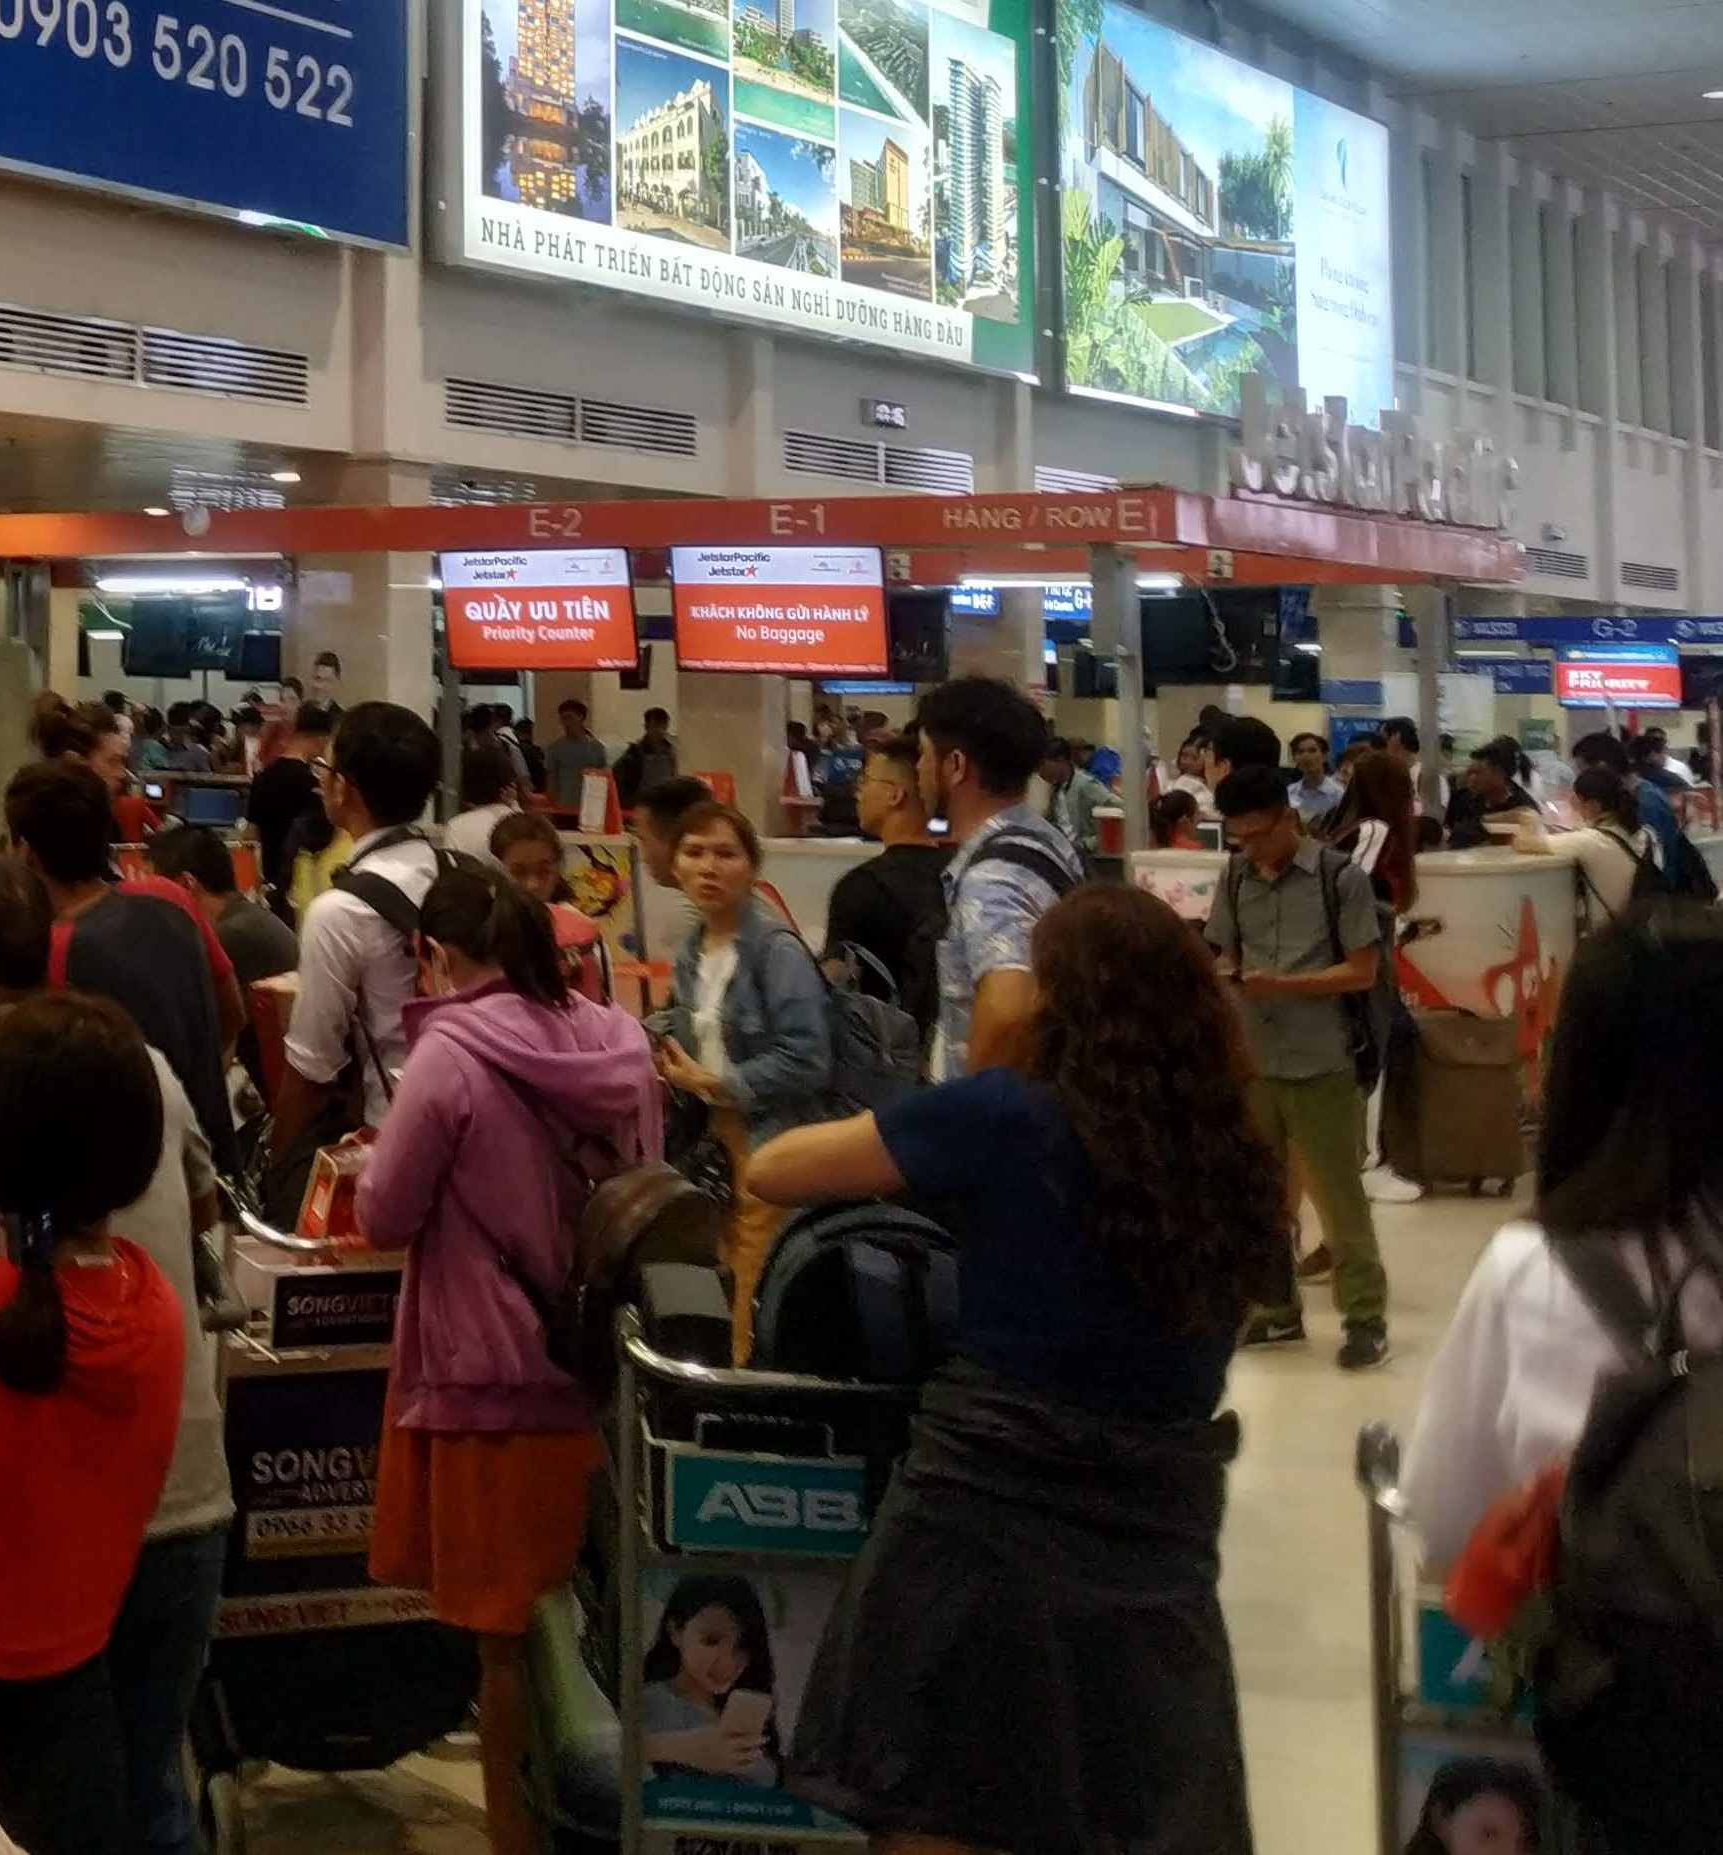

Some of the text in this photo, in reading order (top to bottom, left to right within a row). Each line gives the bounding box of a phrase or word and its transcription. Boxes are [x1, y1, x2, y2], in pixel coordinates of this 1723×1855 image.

[151, 13, 248, 99] 520
[264, 45, 354, 128] 522
[481, 217, 964, 347] NHÀ PHÁT TRIỂN BẤT ĐỘNG SẢN NGHỈ DƯỠNG HÀNG ĐẦU
[530, 507, 583, 537] E-2
[769, 503, 826, 535] E-1
[942, 502, 1022, 530] HÀNG
[1045, 505, 1113, 529] ROW
[1116, 498, 1146, 532] E
[462, 556, 528, 568] JetstarPacific
[697, 551, 771, 563] JetstarPacific
[472, 569, 507, 581] Jetstar
[708, 565, 746, 577] Jetstar
[465, 593, 611, 621] QUẦY ƯU TIÊN
[691, 603, 735, 620] KHÁCH
[737, 603, 784, 620] KHÔNG
[814, 604, 852, 621] HÀNH
[482, 624, 596, 644] Priority Counter
[736, 624, 826, 645] No Baggage
[1591, 618, 1638, 638] G-2
[1567, 669, 1602, 679] SKY
